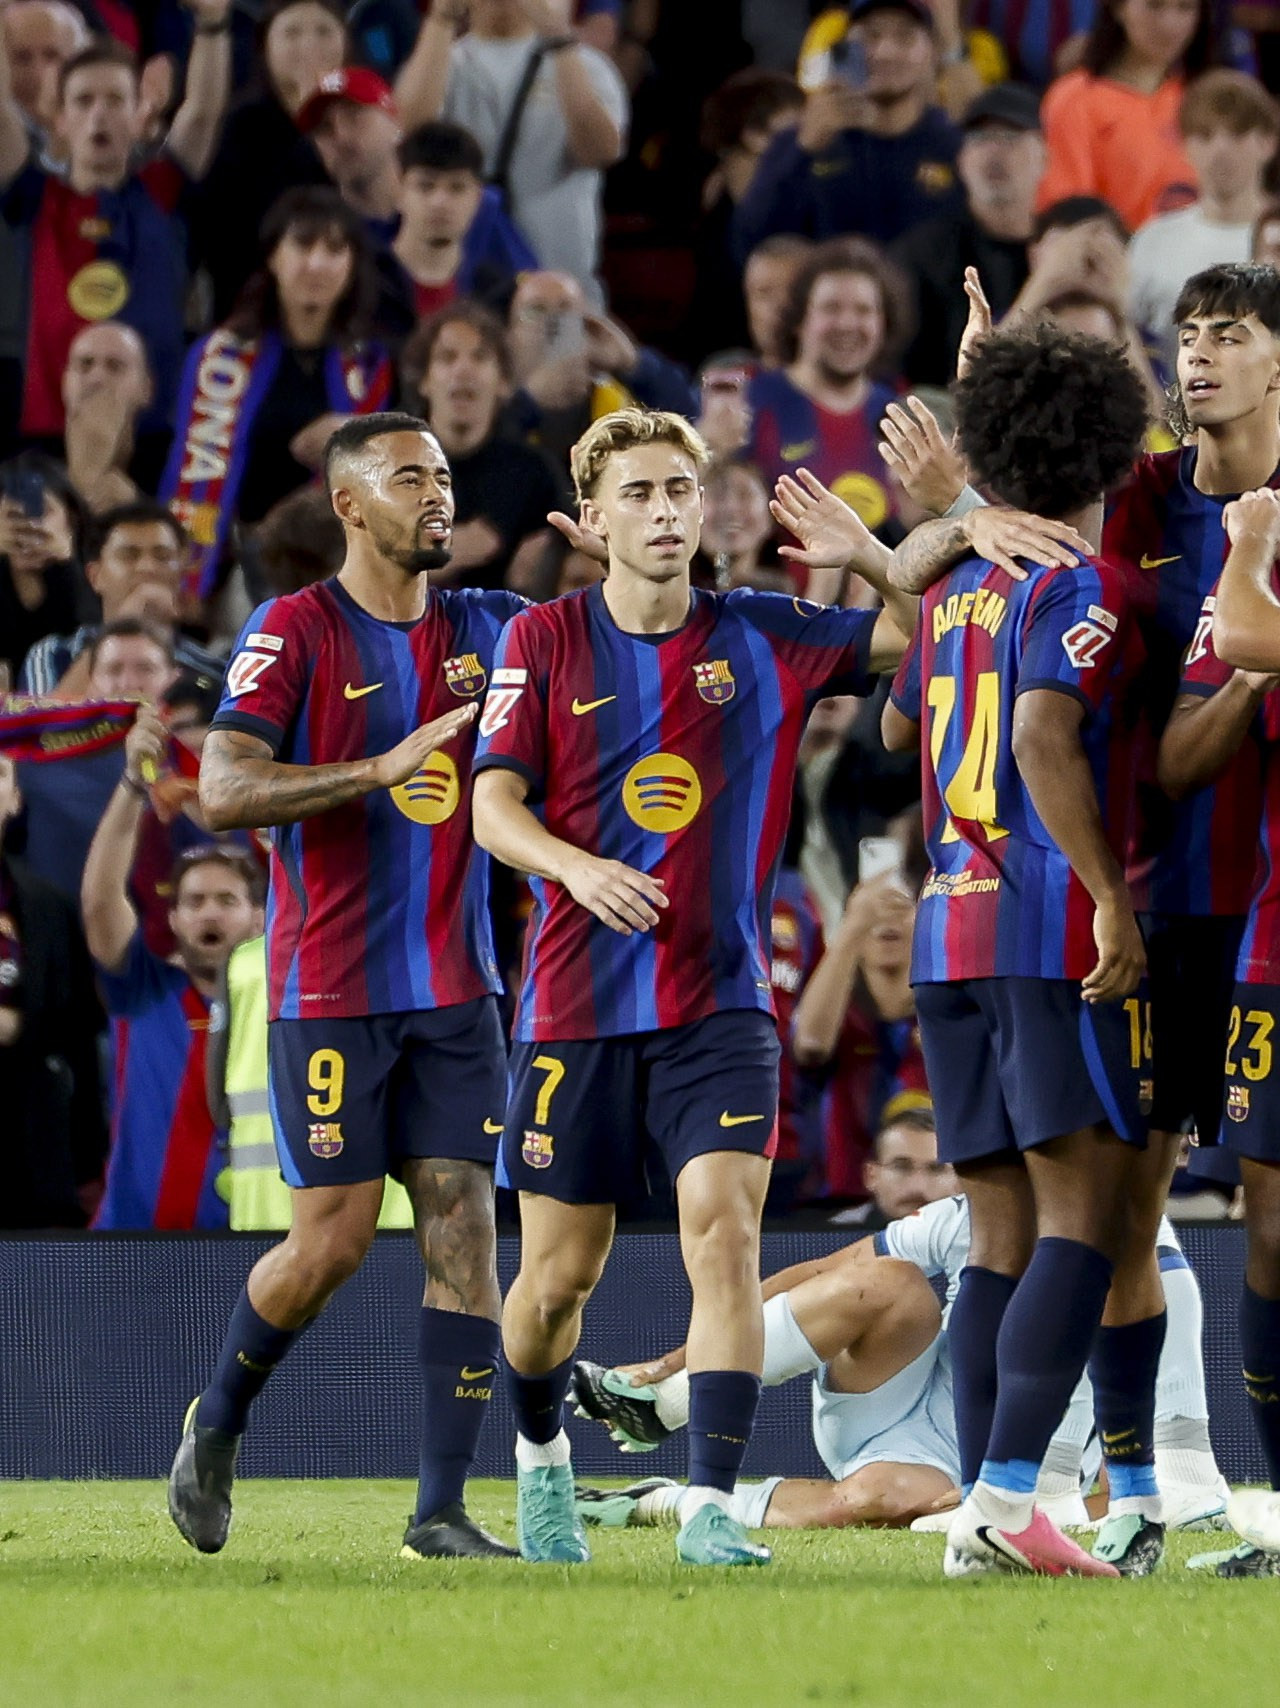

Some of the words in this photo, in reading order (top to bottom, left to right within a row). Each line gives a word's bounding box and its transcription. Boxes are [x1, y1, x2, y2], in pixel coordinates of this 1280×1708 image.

[1225, 1005, 1275, 1081] 23
[307, 1048, 344, 1116] 9
[532, 1055, 565, 1126] 7
